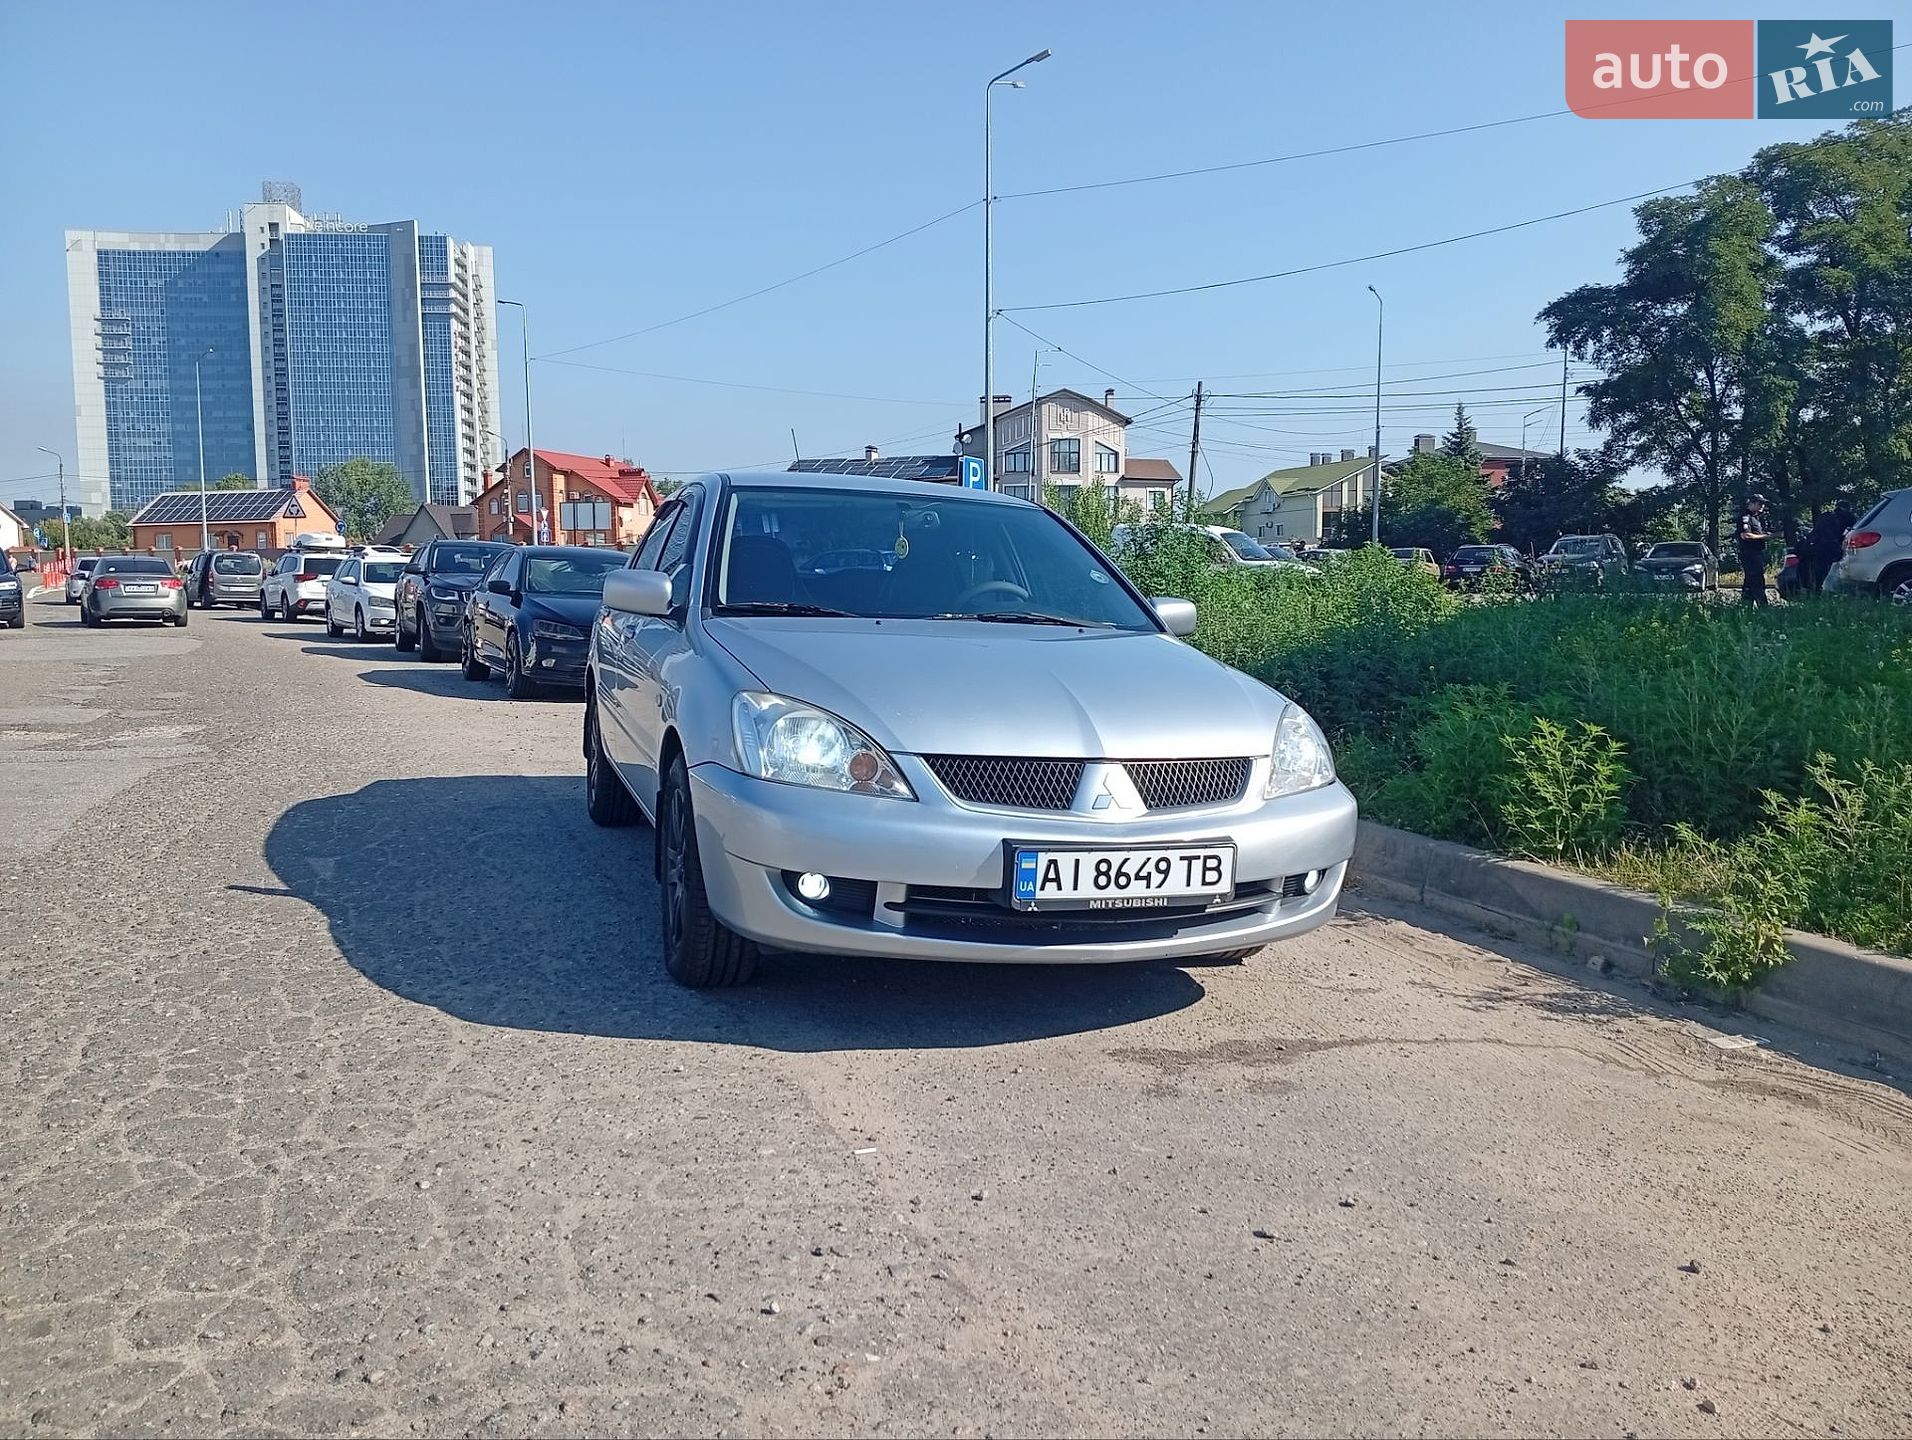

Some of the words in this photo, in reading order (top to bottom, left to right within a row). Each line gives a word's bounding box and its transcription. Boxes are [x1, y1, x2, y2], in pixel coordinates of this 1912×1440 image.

[969, 461, 981, 488] P
[1039, 858, 1080, 891] AI
[1093, 856, 1171, 890] 8649
[1179, 855, 1223, 887] TB
[1019, 881, 1034, 892] UA
[1089, 897, 1168, 909] MITSUBISHI
